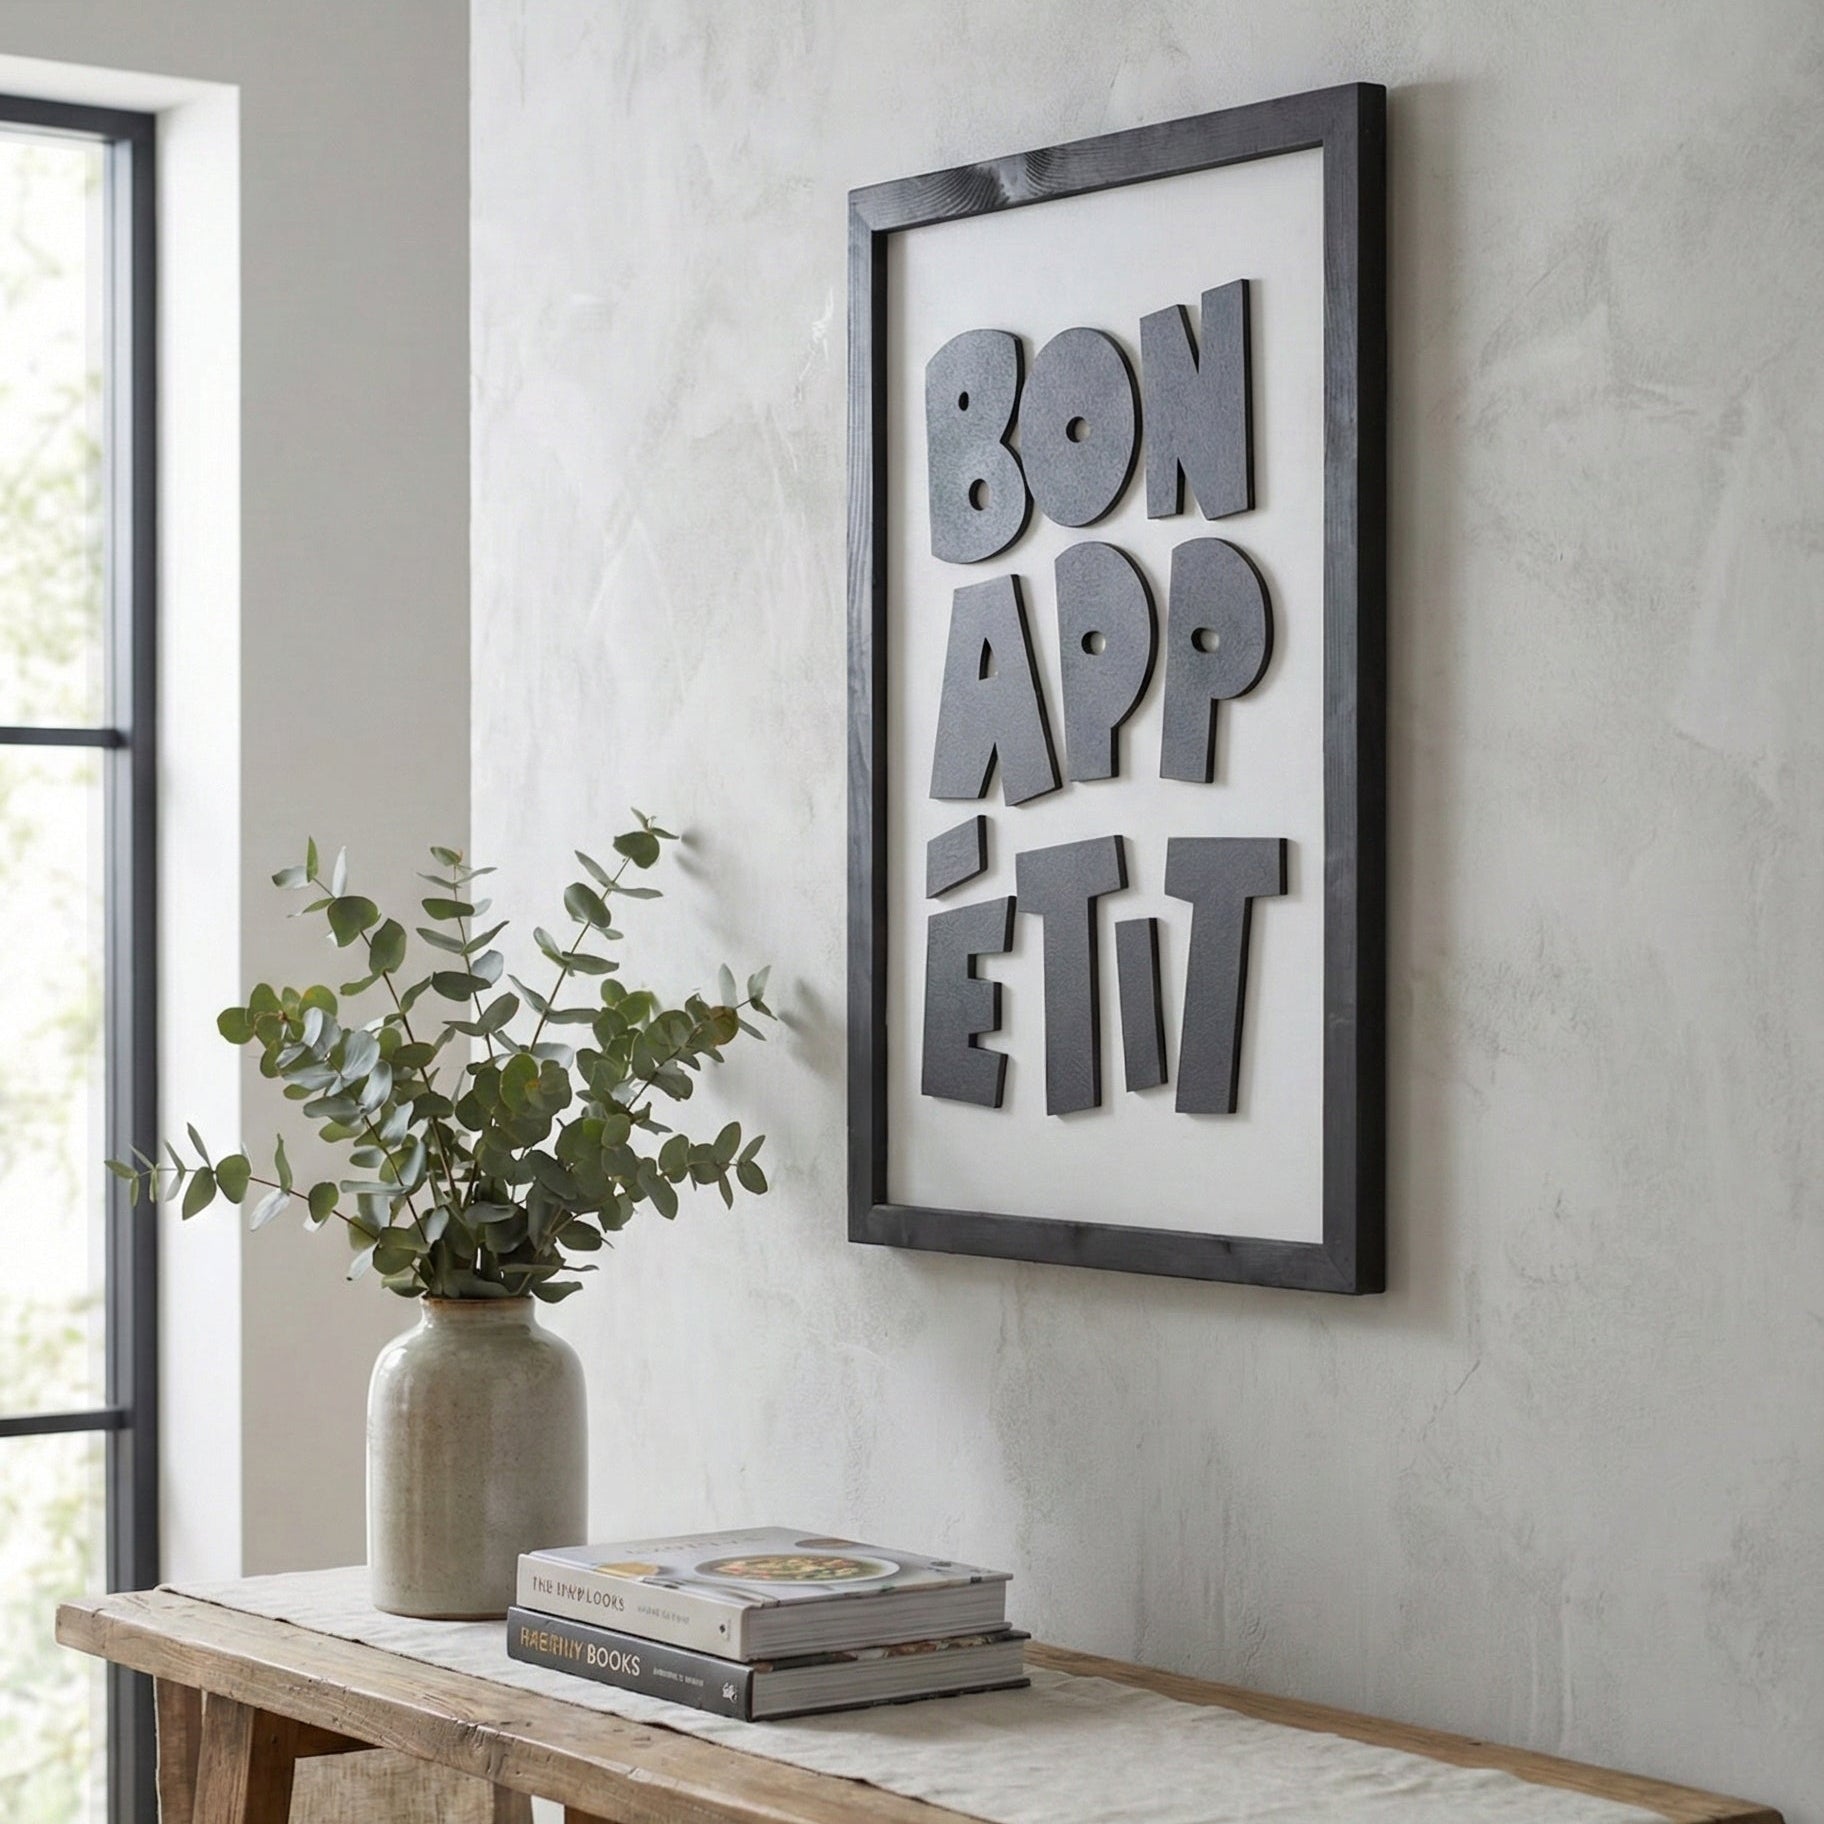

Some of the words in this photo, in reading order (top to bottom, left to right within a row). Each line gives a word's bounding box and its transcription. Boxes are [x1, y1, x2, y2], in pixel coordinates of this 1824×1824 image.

[926, 279, 1256, 564] BON
[930, 538, 1276, 806] APP
[922, 815, 1290, 1117] ÉTIT
[587, 1643, 641, 1677] BOOKS
